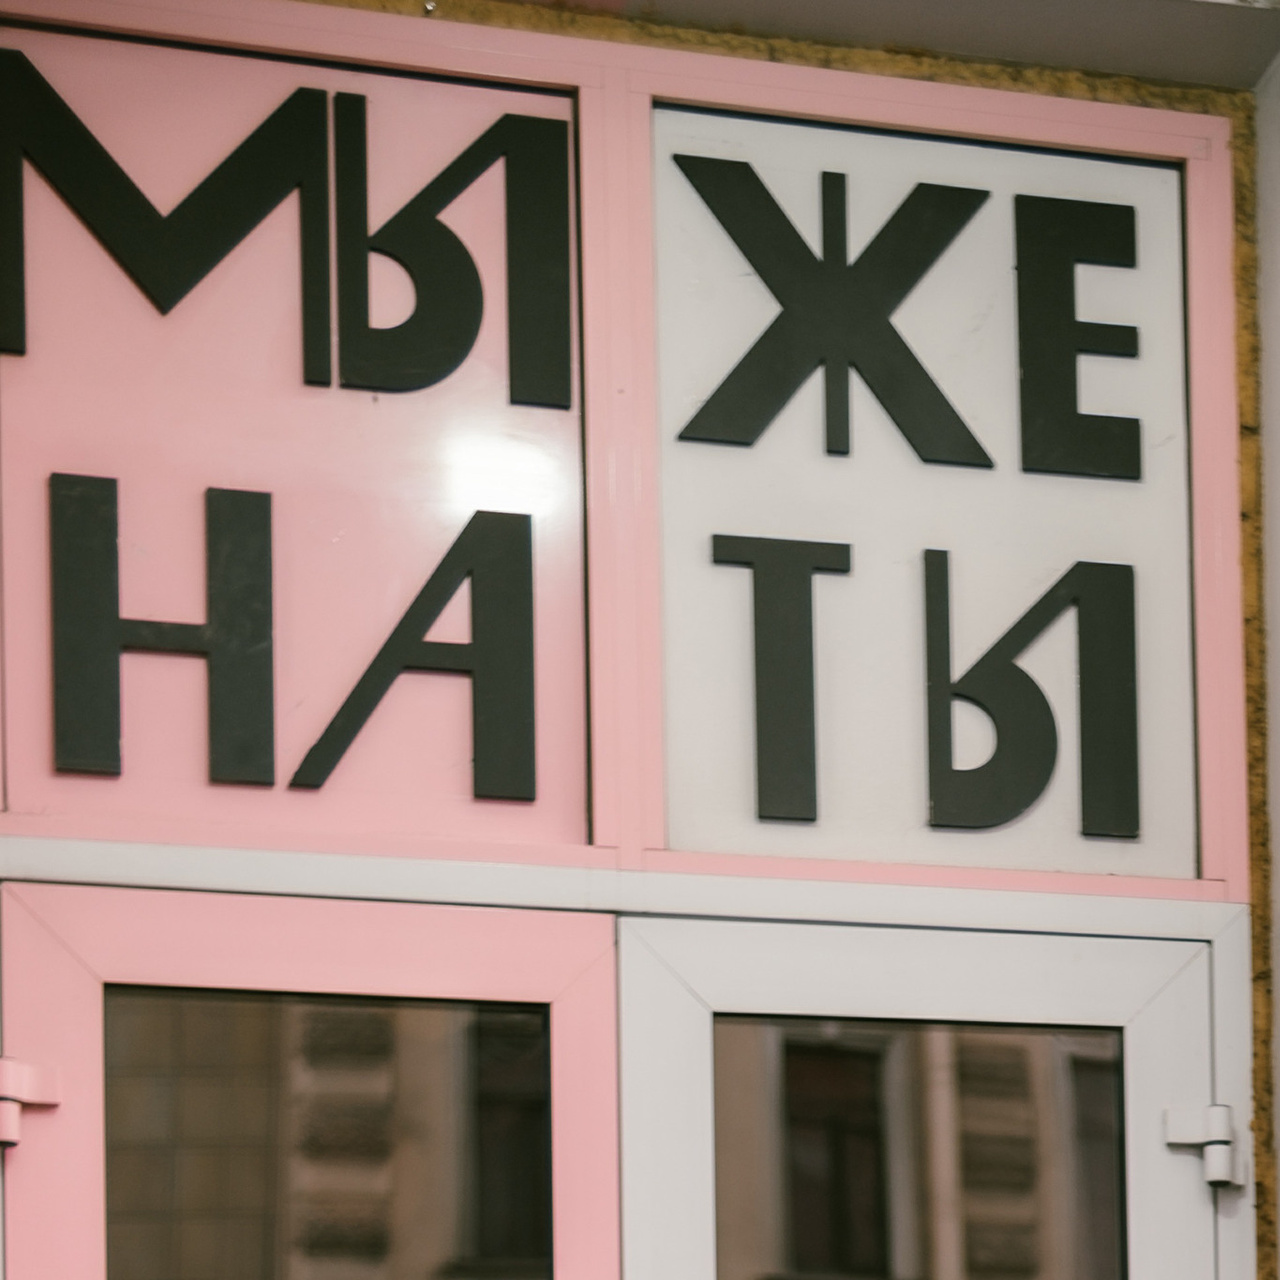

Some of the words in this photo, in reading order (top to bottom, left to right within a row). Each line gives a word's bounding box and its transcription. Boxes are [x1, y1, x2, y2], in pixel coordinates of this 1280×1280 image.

[672, 154, 1141, 481] ЖЕ
[48, 473, 535, 803] НА
[713, 535, 1139, 840] ТЫ
